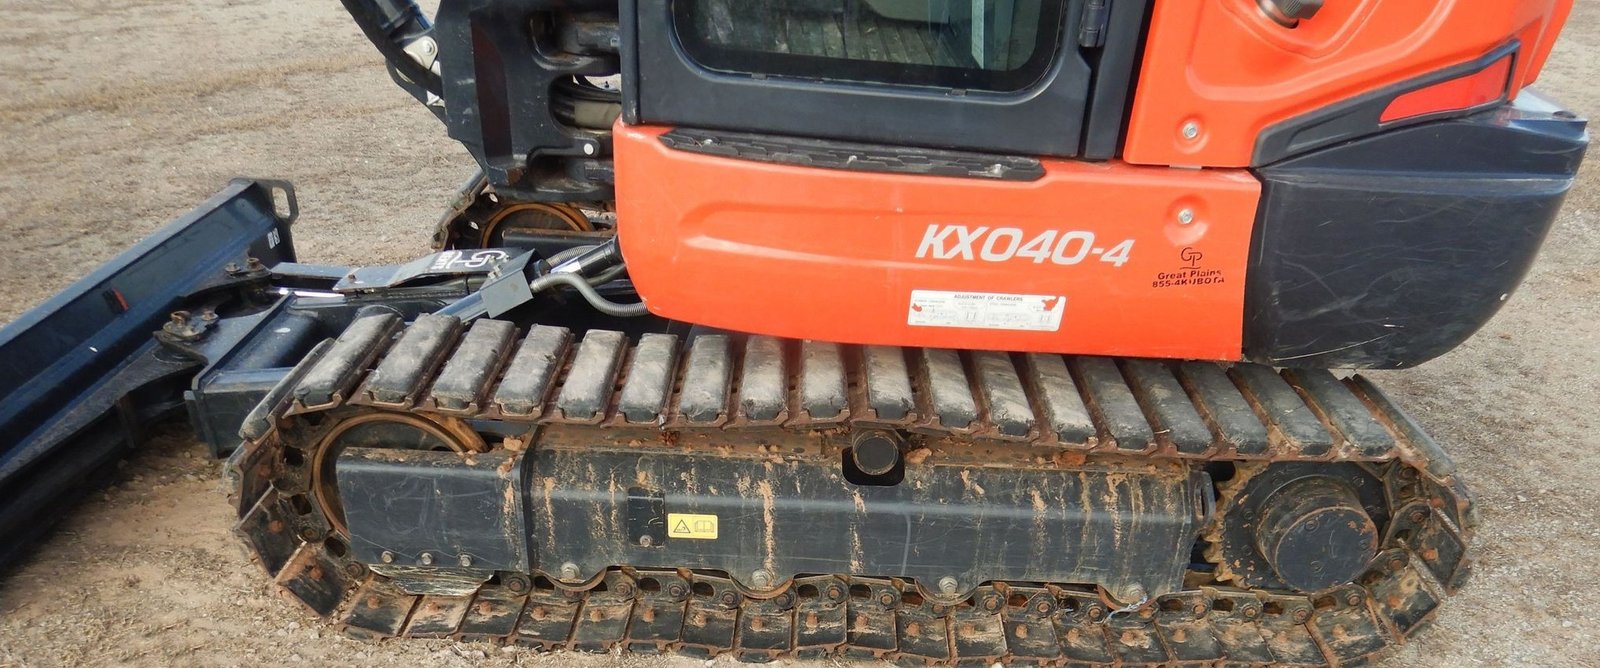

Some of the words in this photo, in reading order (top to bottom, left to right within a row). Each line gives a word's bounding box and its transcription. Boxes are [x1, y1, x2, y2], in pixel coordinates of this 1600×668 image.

[915, 224, 1136, 267] KX040-4
[1157, 271, 1187, 280] Great
[1189, 268, 1222, 278] Plains
[953, 293, 986, 301] ADJUSTMENT
